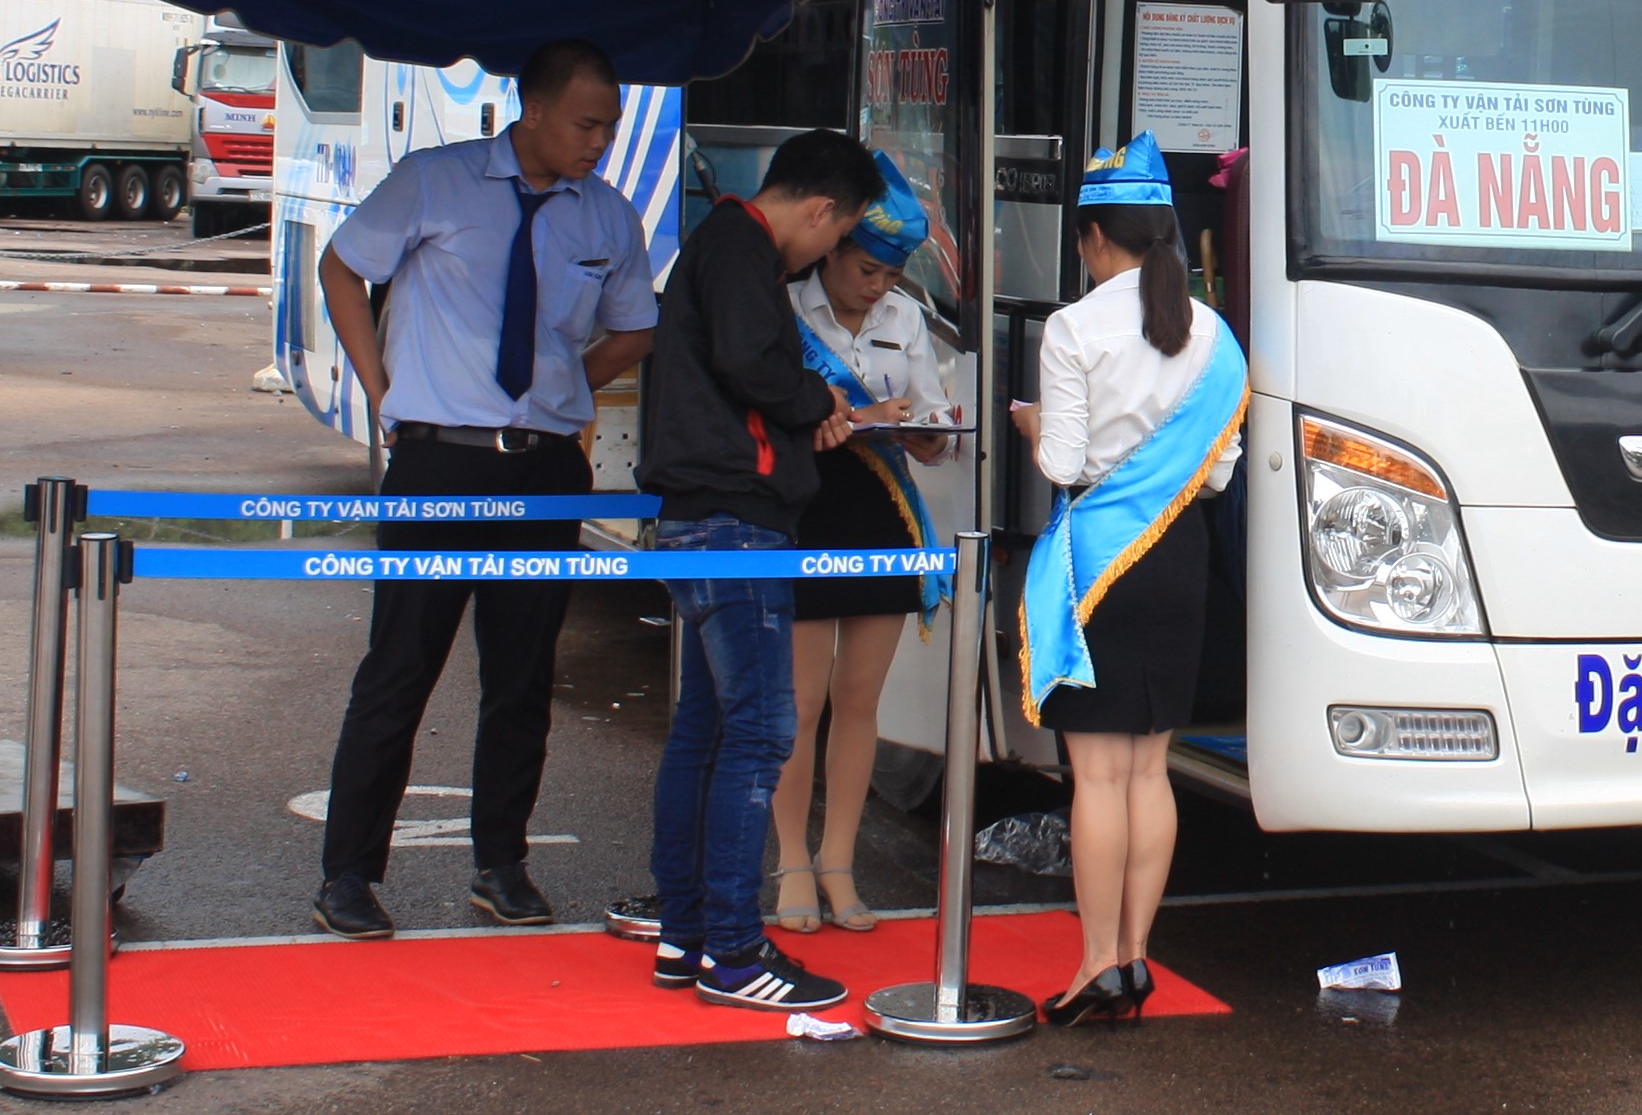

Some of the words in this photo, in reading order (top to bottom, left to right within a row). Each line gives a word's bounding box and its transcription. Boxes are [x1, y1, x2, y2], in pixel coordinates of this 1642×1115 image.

[5, 63, 80, 85] LOGISTICS
[1389, 92, 1436, 108] CÔNG
[1441, 95, 1461, 109] TY
[1465, 92, 1498, 116] VẬN
[1503, 93, 1529, 112] TẢI
[1534, 97, 1568, 113] SƠN
[1573, 97, 1615, 116] TÙNG
[225, 113, 256, 122] MINH
[1438, 114, 1480, 130] XUẤT
[1485, 113, 1516, 132] BẾN
[1521, 119, 1569, 134] 11H00
[1387, 133, 1461, 228] ĐÀ
[1477, 132, 1621, 234] NẴNG
[241, 496, 301, 517] CÔNG
[306, 501, 332, 517] TY
[338, 499, 379, 521] VẬN
[384, 497, 416, 517] TẢI
[421, 500, 466, 518] SƠN
[470, 497, 525, 517] TÙNG
[305, 553, 373, 576] CÔNG
[379, 558, 410, 576] TY
[414, 556, 462, 580] VẬN
[468, 554, 505, 576] TẢI
[510, 556, 560, 576] SƠN
[566, 553, 628, 576] TÙNG
[802, 552, 865, 574] CÔNG
[869, 554, 897, 572] TY
[900, 551, 944, 575] VẬN
